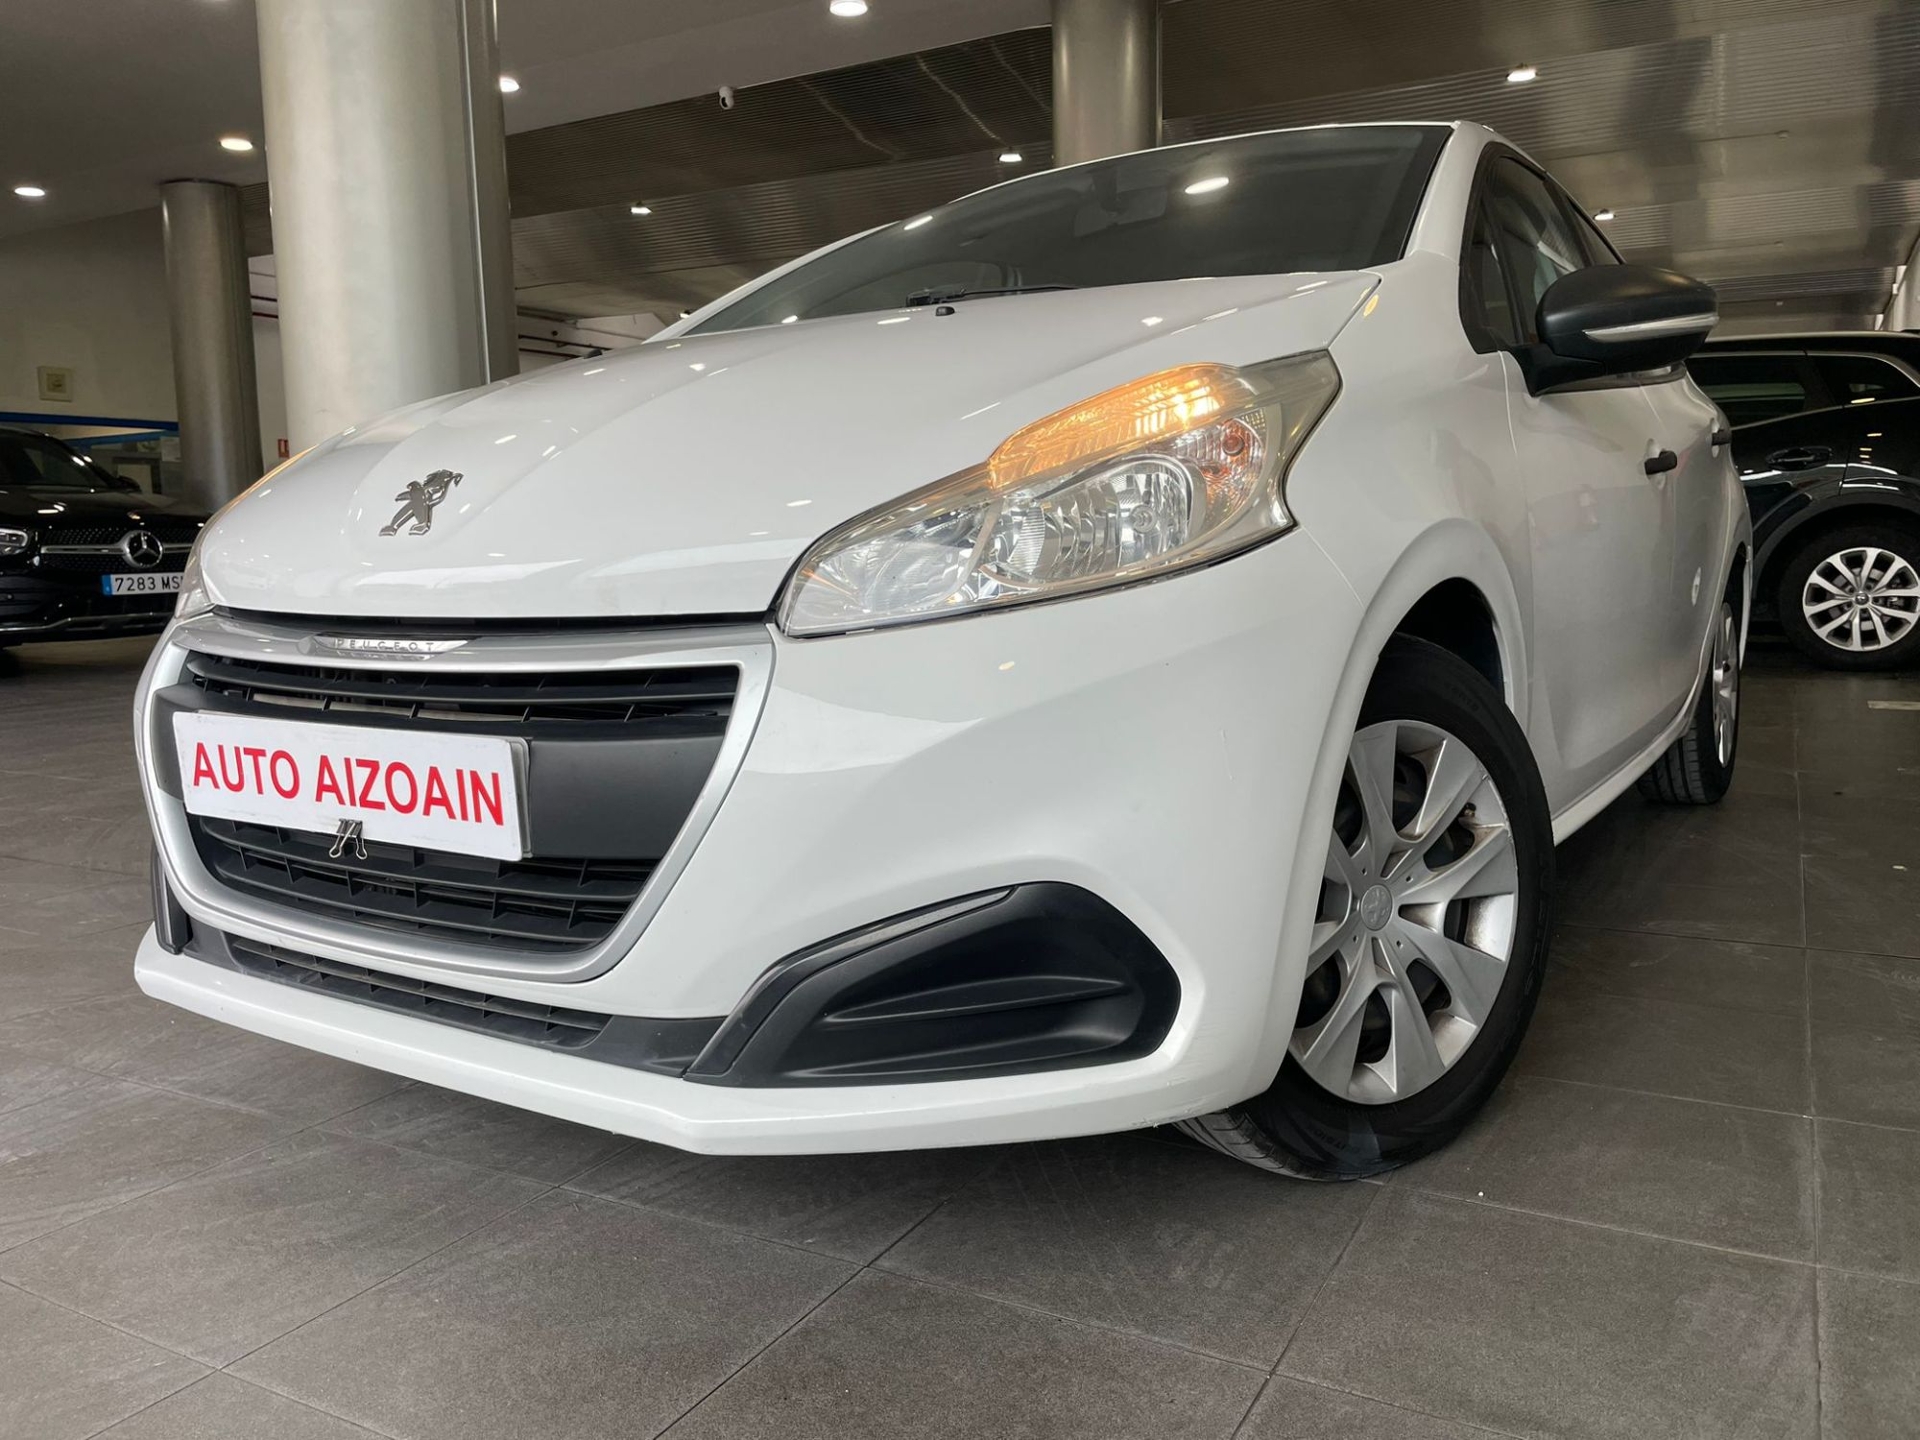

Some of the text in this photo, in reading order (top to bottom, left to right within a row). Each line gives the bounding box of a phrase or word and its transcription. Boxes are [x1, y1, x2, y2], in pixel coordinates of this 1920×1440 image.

[115, 575, 183, 592] 7283 MS
[335, 639, 434, 652] PEUGEOT
[193, 742, 504, 826] AUTO AIZOAIN
